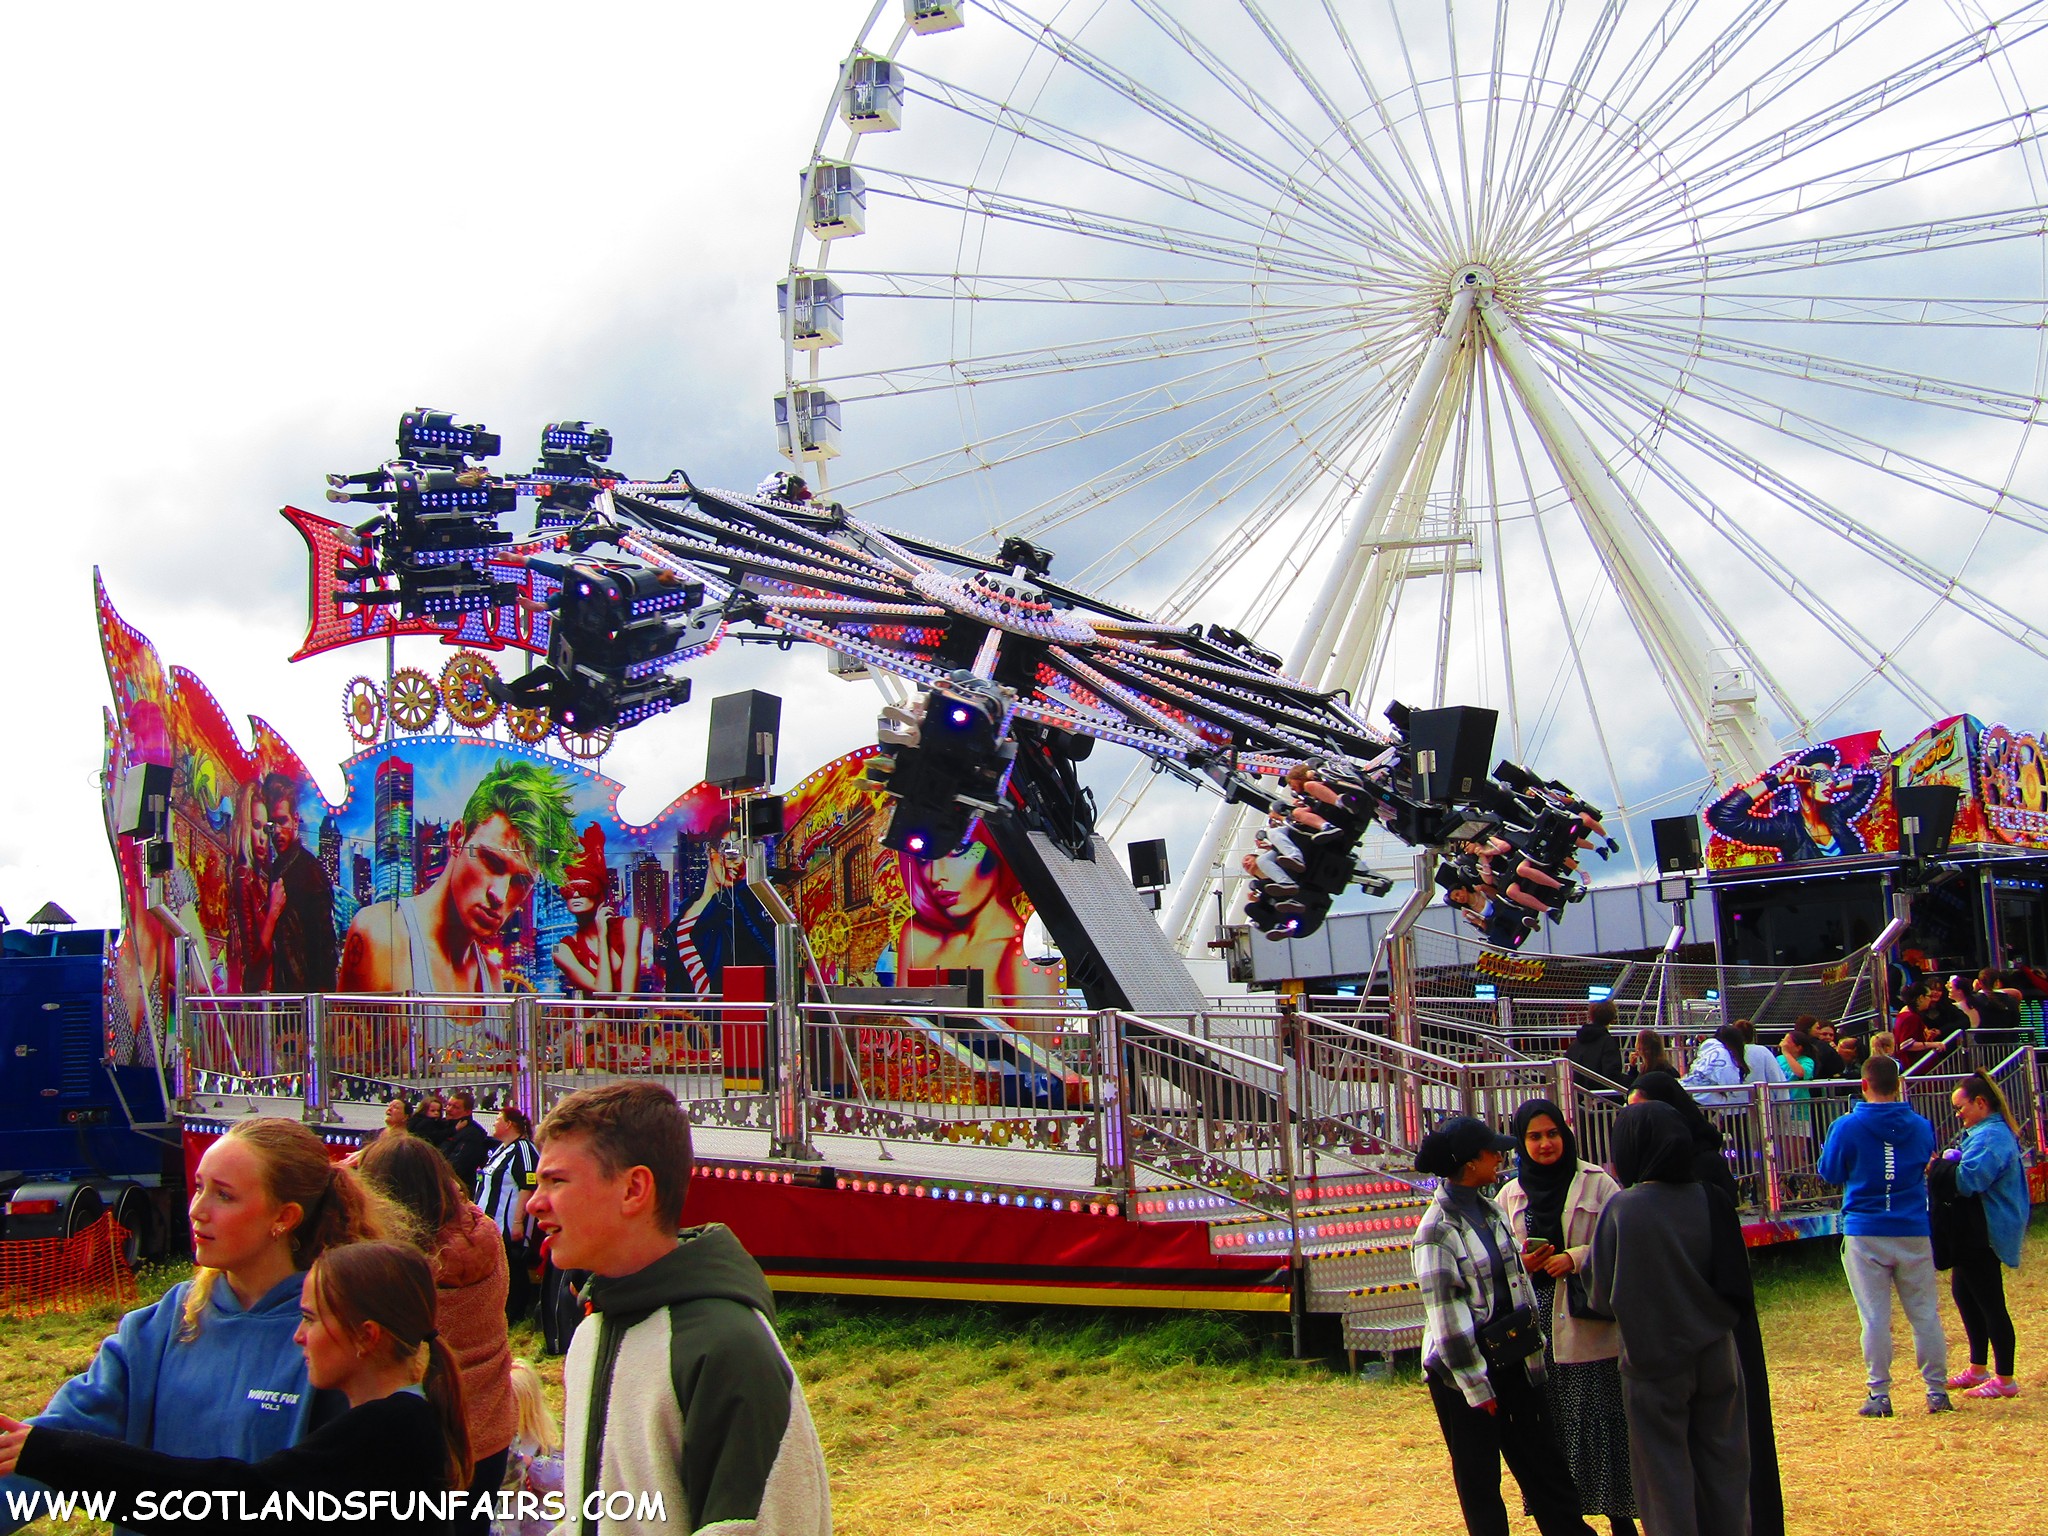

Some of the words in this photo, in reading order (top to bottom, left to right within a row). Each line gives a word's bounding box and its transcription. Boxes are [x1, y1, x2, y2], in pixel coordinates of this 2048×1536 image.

[1987, 805, 2048, 834] TICKET
[247, 1389, 279, 1402] WHITE
[279, 1393, 300, 1404] FOX
